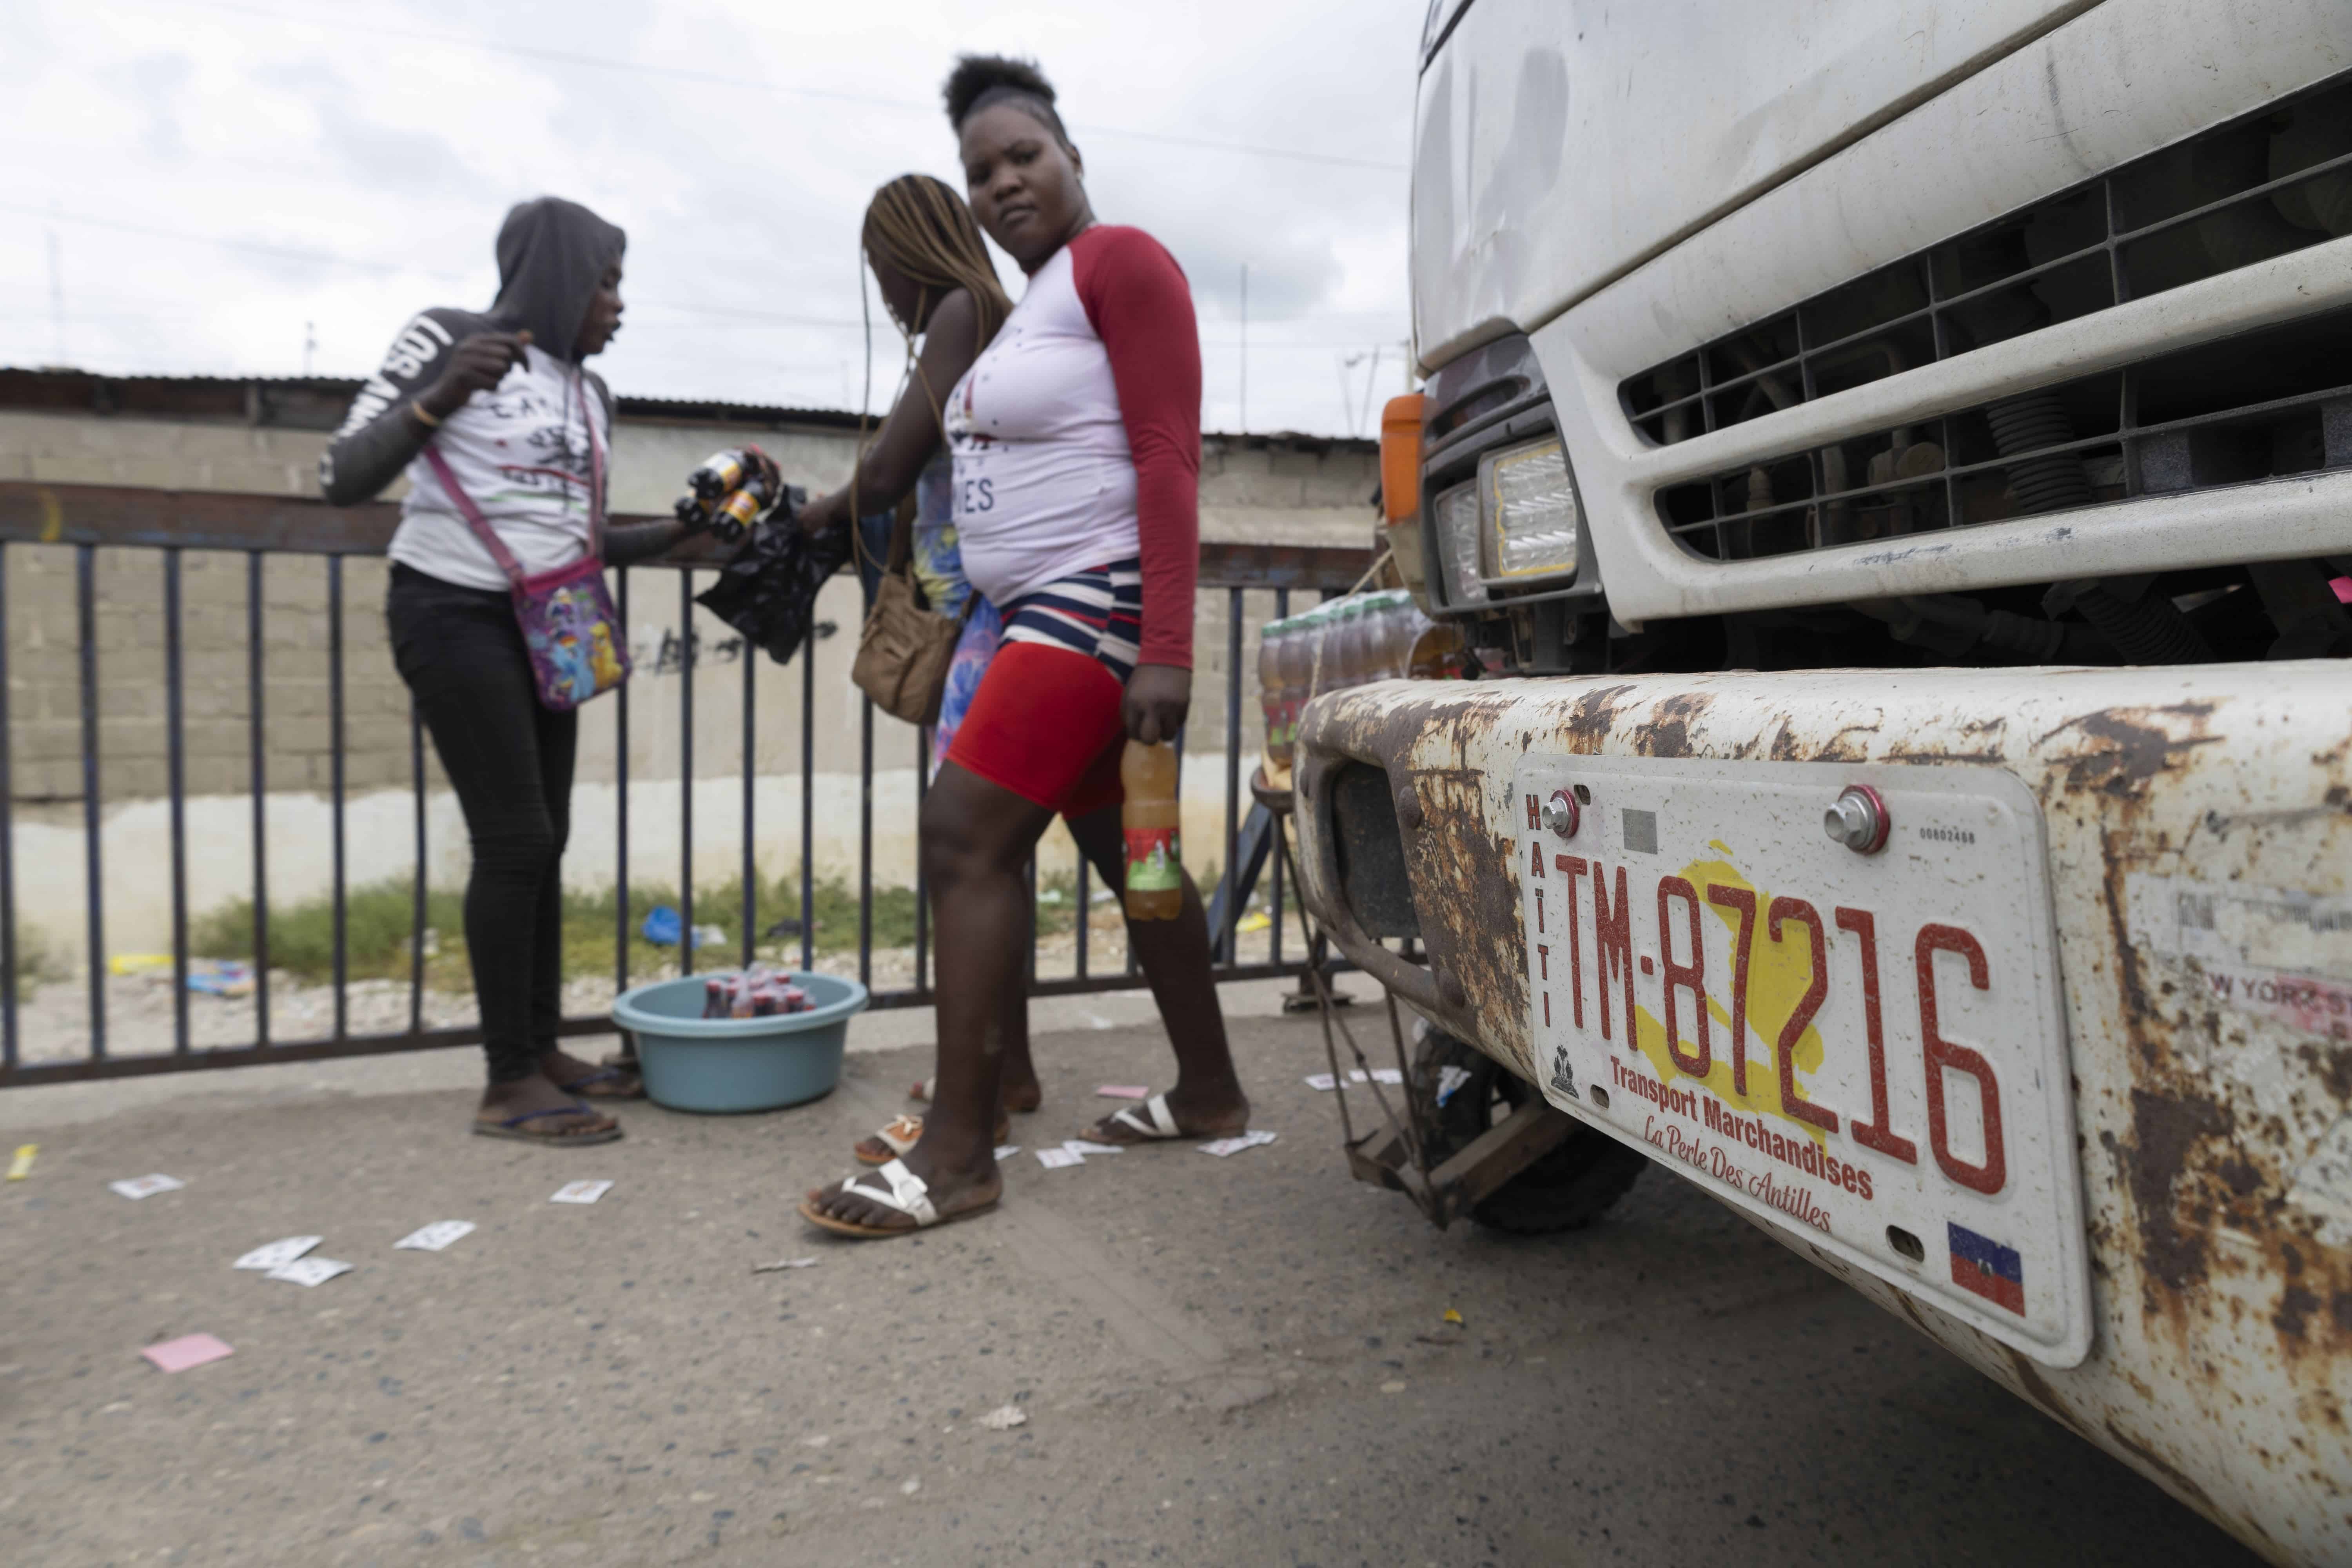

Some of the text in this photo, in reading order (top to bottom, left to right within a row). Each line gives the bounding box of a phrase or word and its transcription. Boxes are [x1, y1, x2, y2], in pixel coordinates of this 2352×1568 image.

[954, 478, 994, 514] ES
[1526, 794, 1550, 1028] HAÏTI
[1555, 854, 2006, 1195] TM-87216
[1610, 1055, 1873, 1201] Transport Marchandises
[1644, 1115, 1830, 1233] La Perle Des Antilles
